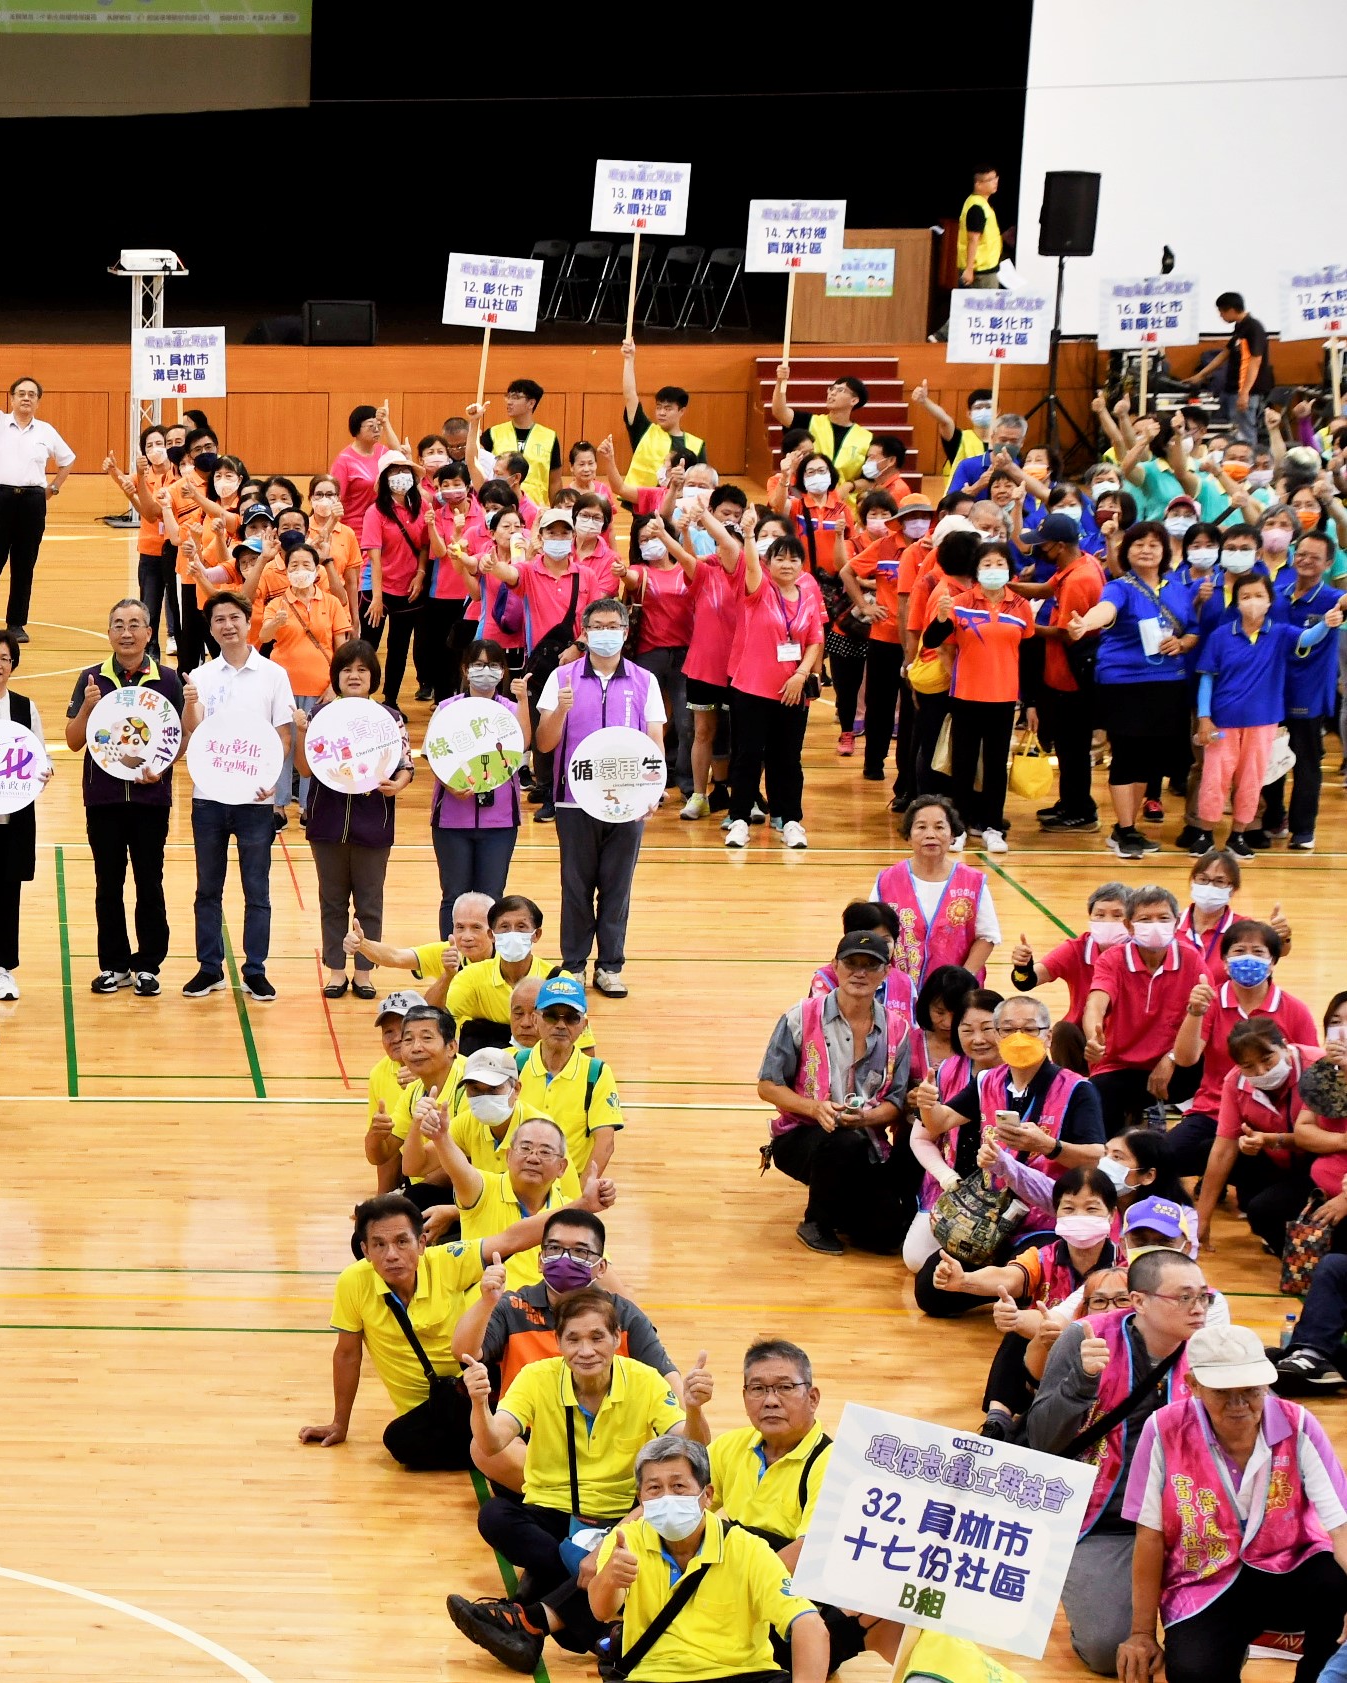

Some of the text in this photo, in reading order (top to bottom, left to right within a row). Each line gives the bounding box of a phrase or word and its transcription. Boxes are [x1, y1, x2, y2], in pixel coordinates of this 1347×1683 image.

[612, 187, 671, 201] 13. 鹿港鎮
[765, 227, 827, 239] 14. 大村鄉
[464, 281, 523, 297] 12. 彰化市
[465, 296, 517, 312] 香山社區
[1117, 301, 1182, 315] 16. 彰化市
[968, 317, 1033, 329] 15. 彰化市
[970, 333, 1028, 345] 竹中社區
[149, 353, 209, 366] 11. 員林市
[153, 368, 206, 381] 溝皂社區
[307, 716, 398, 763] 愛惜資源
[428, 713, 516, 760] 綠色飲食
[204, 739, 262, 758] 美好彰化
[355, 739, 401, 758] Cherish resources
[212, 757, 258, 776] 希望城市
[571, 755, 663, 782] 循環再生
[862, 1487, 1033, 1557] 32. 員林市
[1172, 1474, 1204, 1573] 富貴社區
[843, 1526, 1031, 1602] 十七份社區
[898, 1582, 947, 1620] B組
